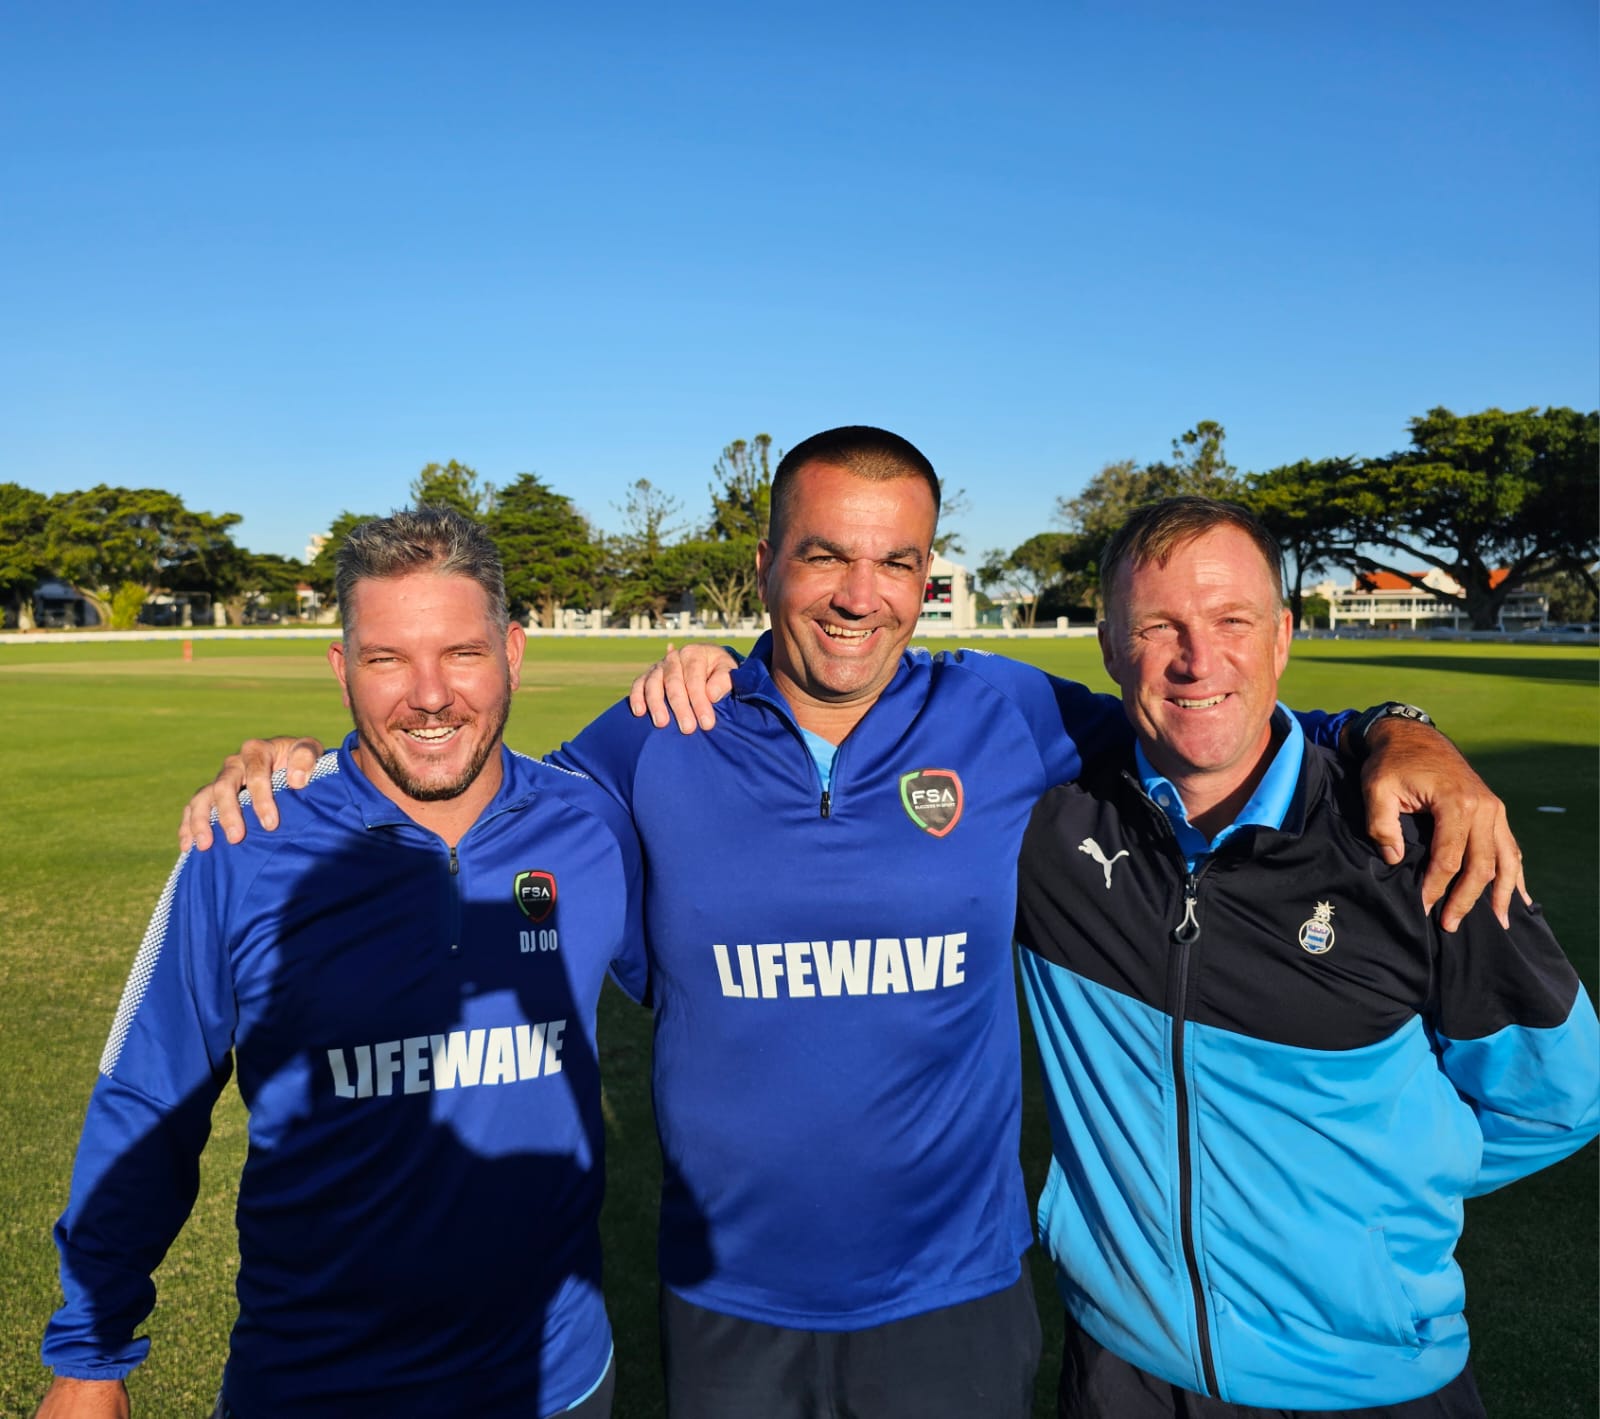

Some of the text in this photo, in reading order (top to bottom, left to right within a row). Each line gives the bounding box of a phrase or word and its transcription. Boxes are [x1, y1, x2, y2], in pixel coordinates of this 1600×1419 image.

[912, 788, 954, 804] FSA
[521, 886, 550, 897] FSA
[519, 930, 536, 953] DJ
[713, 932, 967, 999] LIFEWAVE
[327, 1019, 567, 1099] LIFEWAVE
